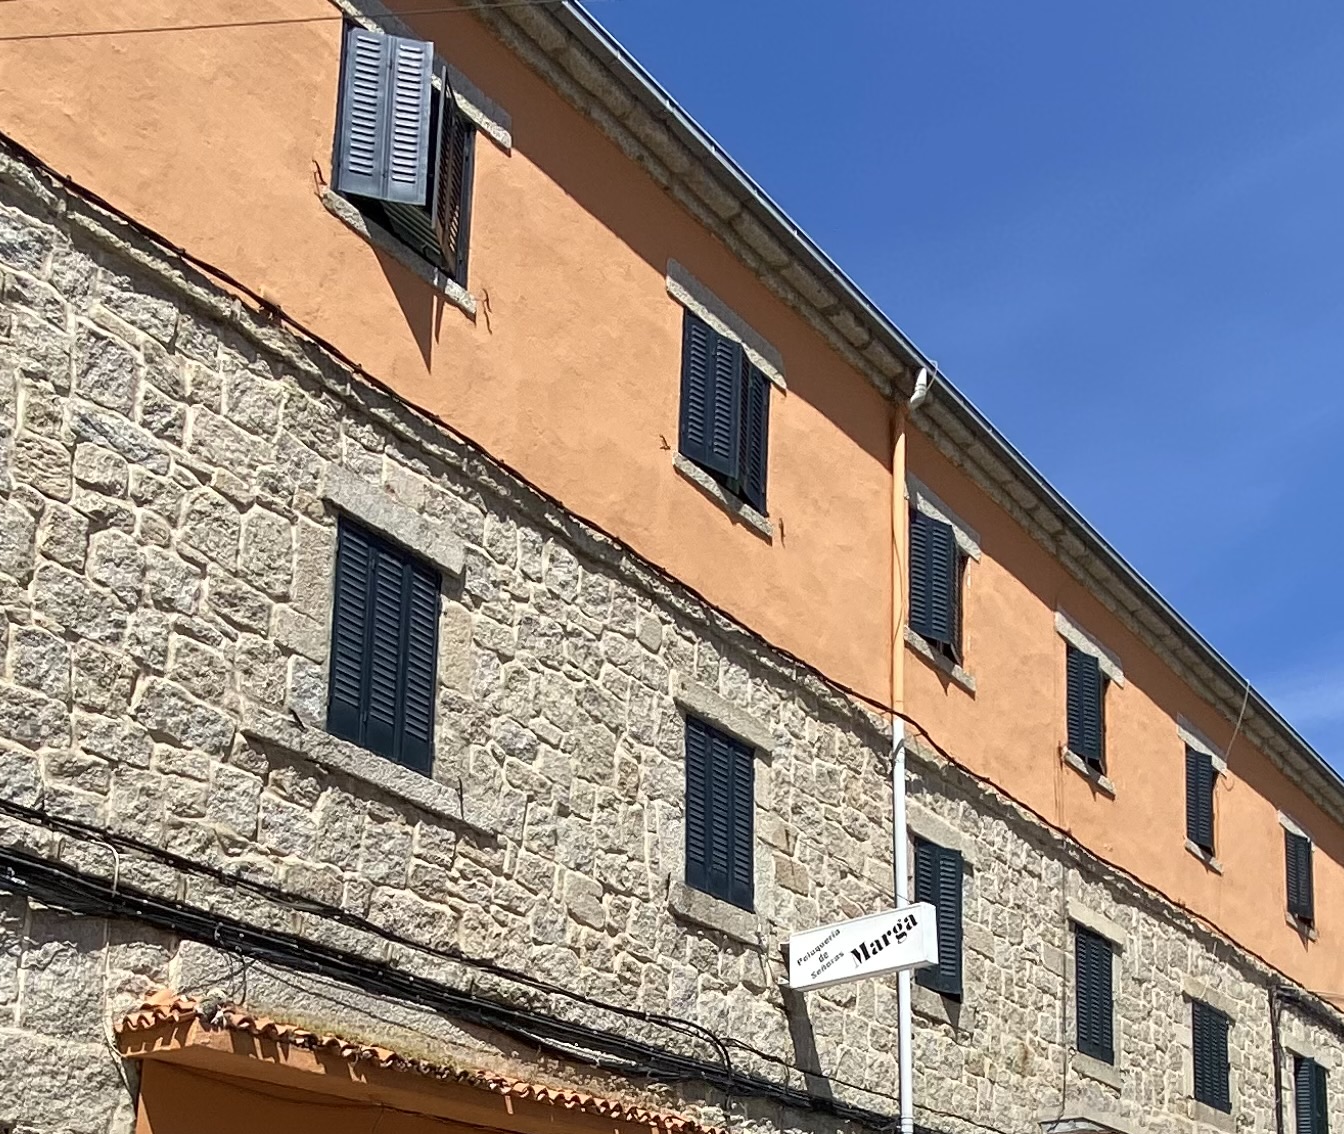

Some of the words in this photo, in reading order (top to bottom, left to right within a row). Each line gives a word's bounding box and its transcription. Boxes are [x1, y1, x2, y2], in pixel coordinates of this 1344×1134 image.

[797, 929, 840, 966] Peluquería
[818, 952, 829, 963] de
[850, 913, 918, 969] Marga
